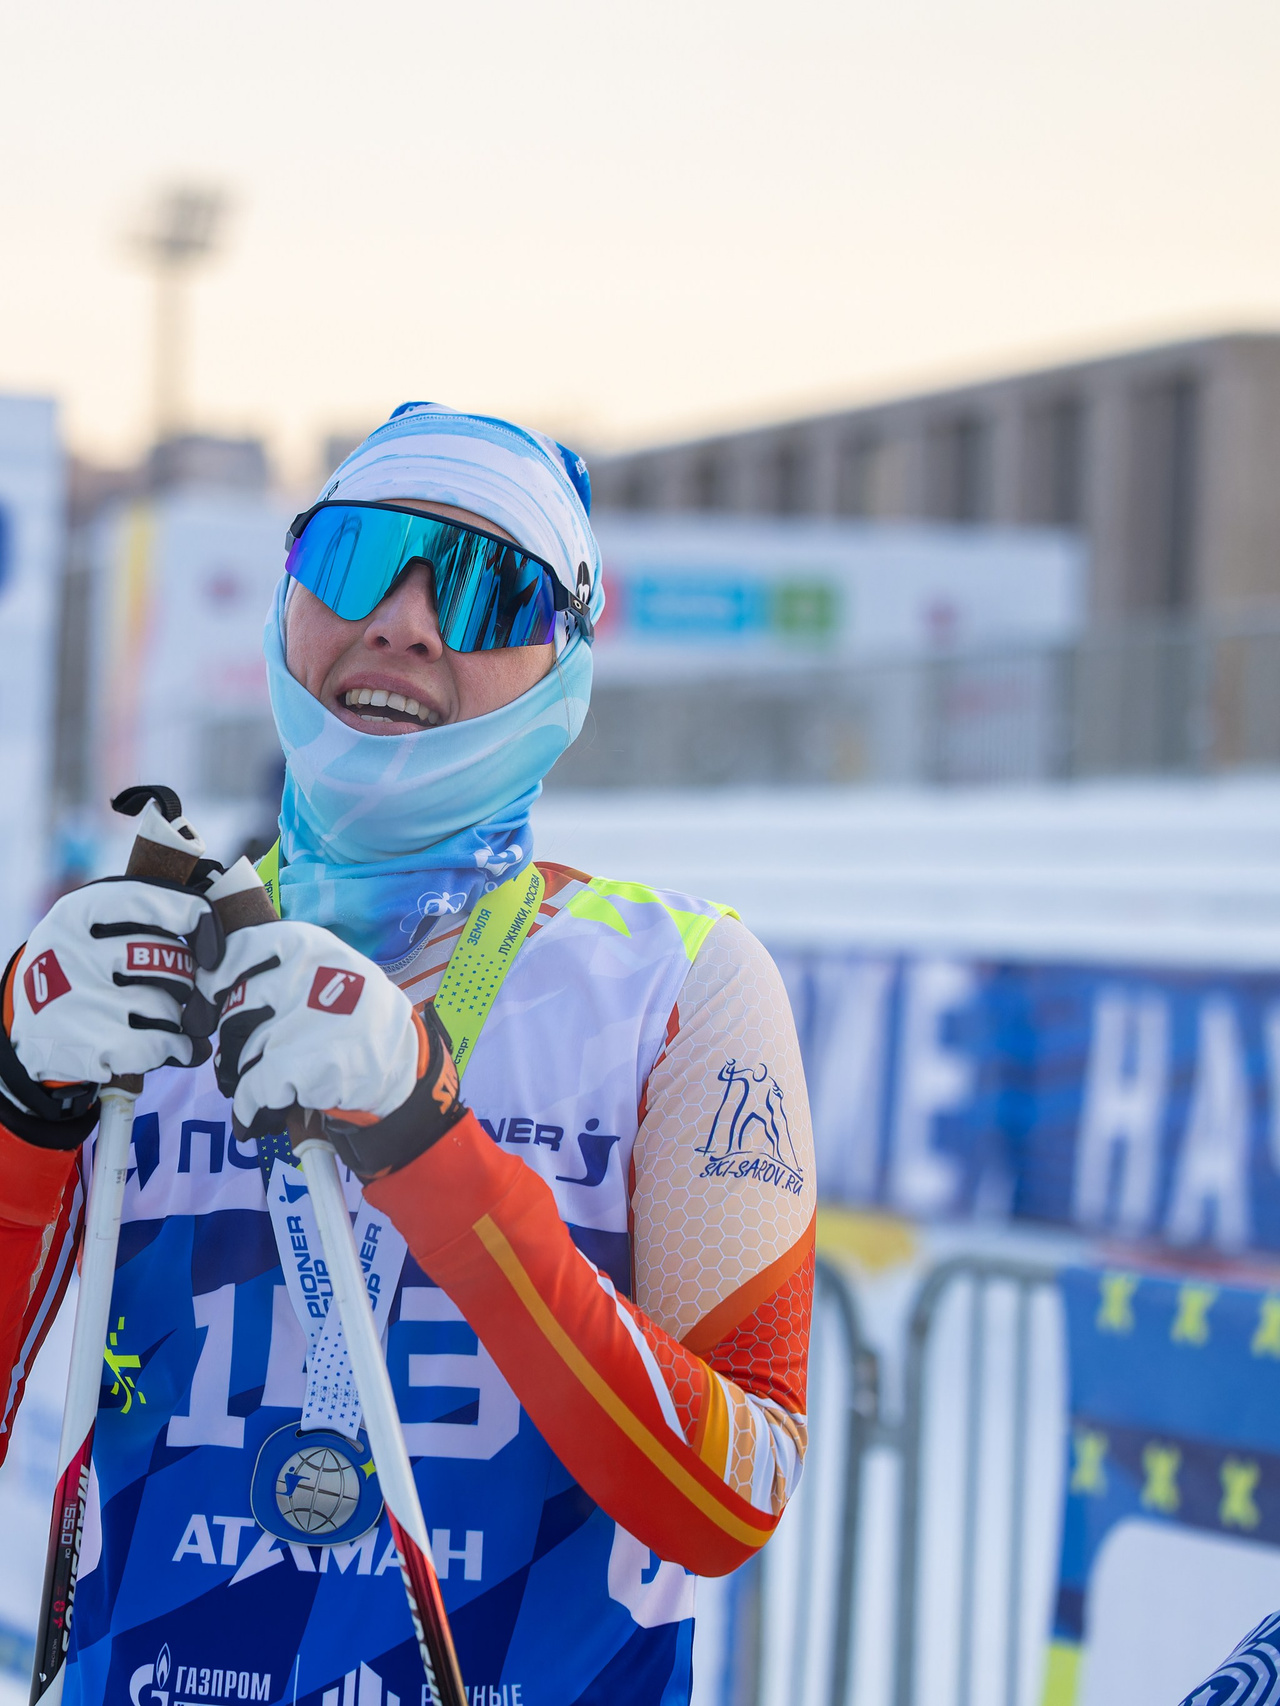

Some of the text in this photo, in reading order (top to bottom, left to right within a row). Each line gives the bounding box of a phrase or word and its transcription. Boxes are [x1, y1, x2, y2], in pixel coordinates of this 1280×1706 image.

[467, 908, 492, 946] ЗЕМЛЯ
[498, 873, 540, 956] ЛУЖНИКИ, МОСКВА
[132, 946, 194, 974] BIVIU
[477, 1117, 565, 1152] NER
[286, 1215, 326, 1318] PIONER
[175, 1665, 272, 1701] ГАЗПРОМ
[420, 1683, 524, 1706] РНЫЕ
